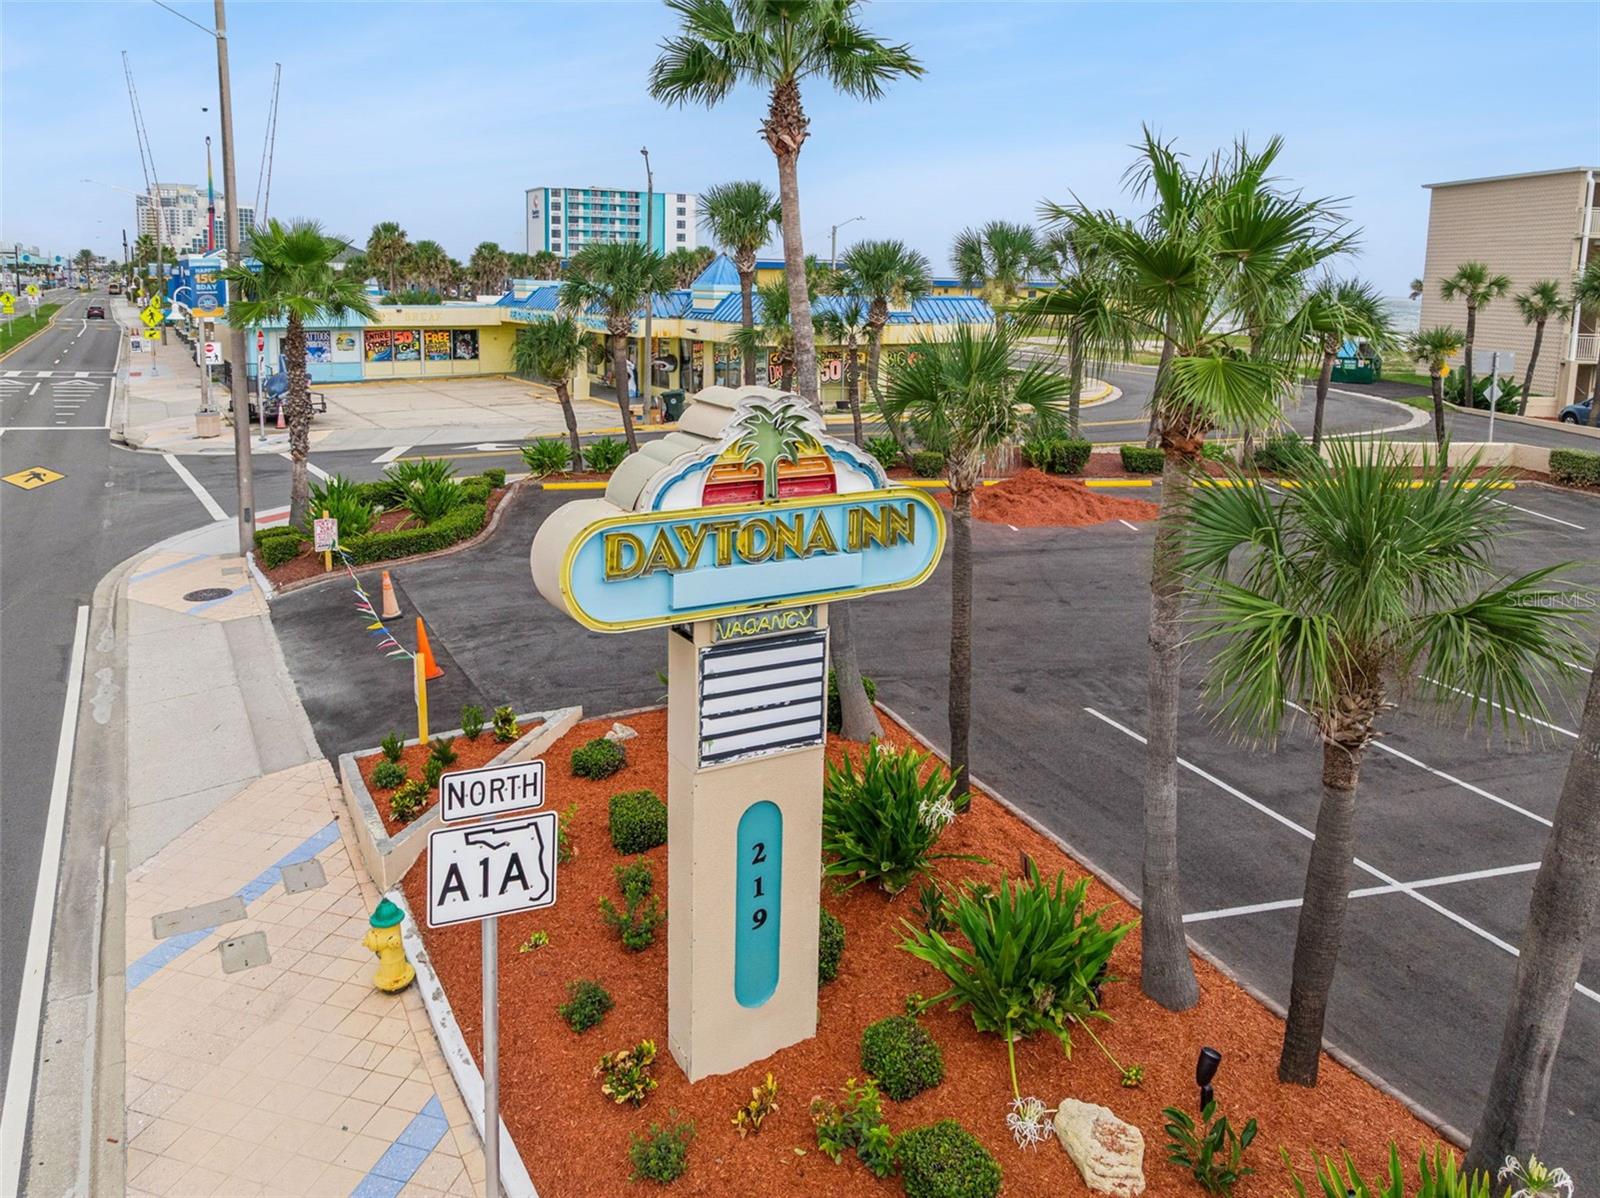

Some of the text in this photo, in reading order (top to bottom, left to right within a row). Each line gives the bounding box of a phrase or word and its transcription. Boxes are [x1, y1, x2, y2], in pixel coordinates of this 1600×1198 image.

[367, 340, 390, 351] STORE
[425, 332, 450, 343] FREE
[604, 502, 916, 582] DAYTONA INN
[715, 608, 813, 640] VACANCY
[448, 772, 538, 811] NORTH
[437, 852, 530, 907] A1A
